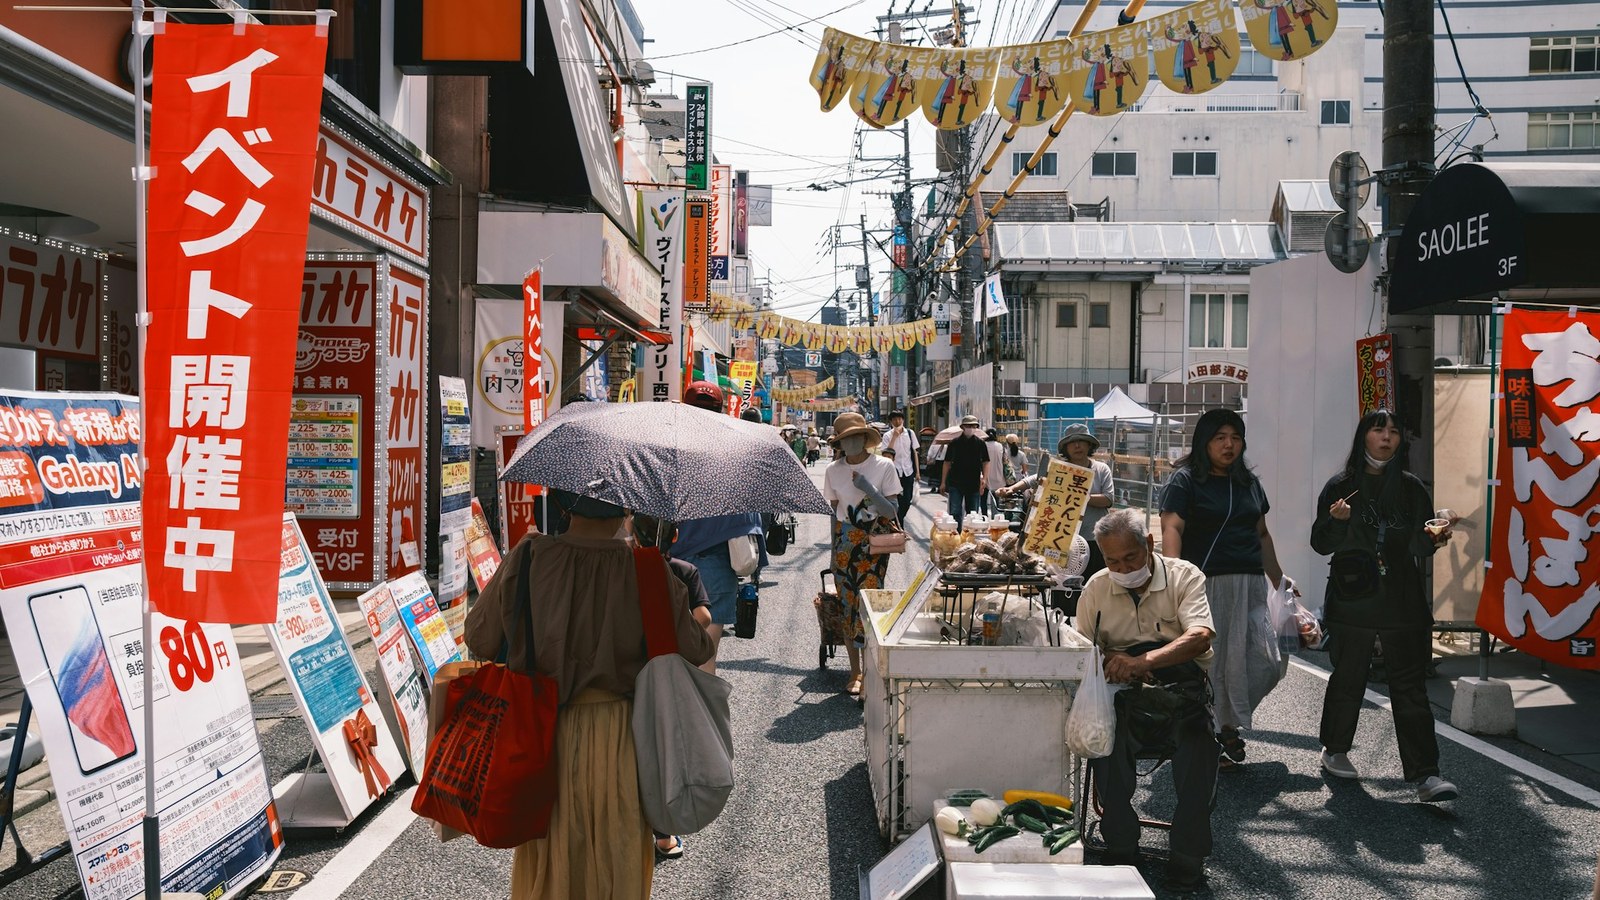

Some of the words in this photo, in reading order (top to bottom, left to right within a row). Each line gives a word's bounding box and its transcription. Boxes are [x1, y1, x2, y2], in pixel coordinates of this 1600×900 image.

[696, 104, 705, 127] 24時間
[313, 137, 418, 244] カラオケ
[1418, 213, 1489, 262] SAOLEE
[712, 258, 724, 270] 方
[1498, 256, 1517, 276] 3F
[0, 246, 94, 349] ラオケ
[164, 48, 279, 592] イベント開催中
[1507, 377, 1532, 439] 味自慢
[40, 455, 120, 496] Galaxy
[1053, 475, 1089, 550] 黒にんにく
[30, 538, 96, 557] 他社からお乗りかえ
[318, 529, 358, 548] 受付
[312, 552, 364, 571] EV3F
[126, 660, 146, 679] 負担
